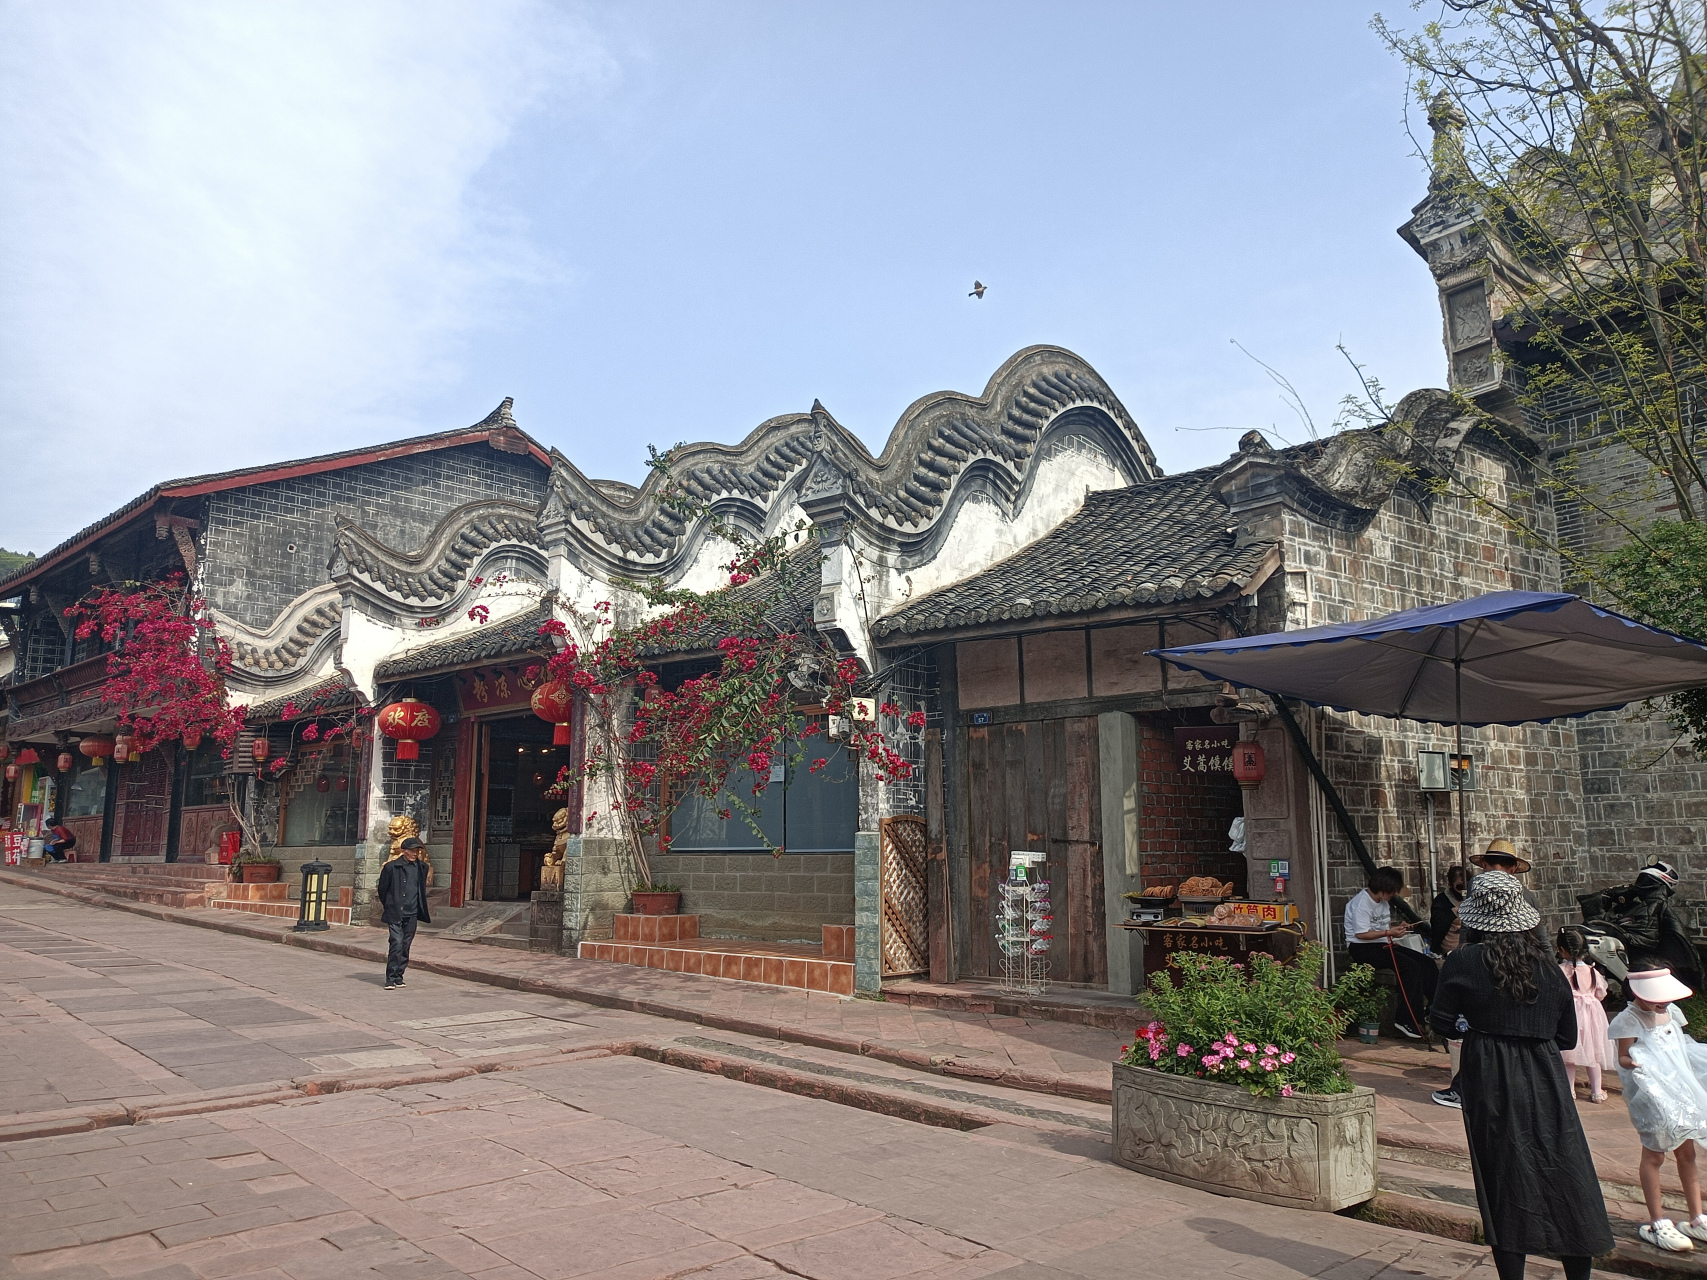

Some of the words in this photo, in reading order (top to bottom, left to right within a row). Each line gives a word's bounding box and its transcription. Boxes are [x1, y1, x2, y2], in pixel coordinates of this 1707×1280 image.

[386, 706, 433, 728] 欢度
[1185, 738, 1231, 751] 客家名小吃
[1163, 932, 1229, 951] 客家名小吃
